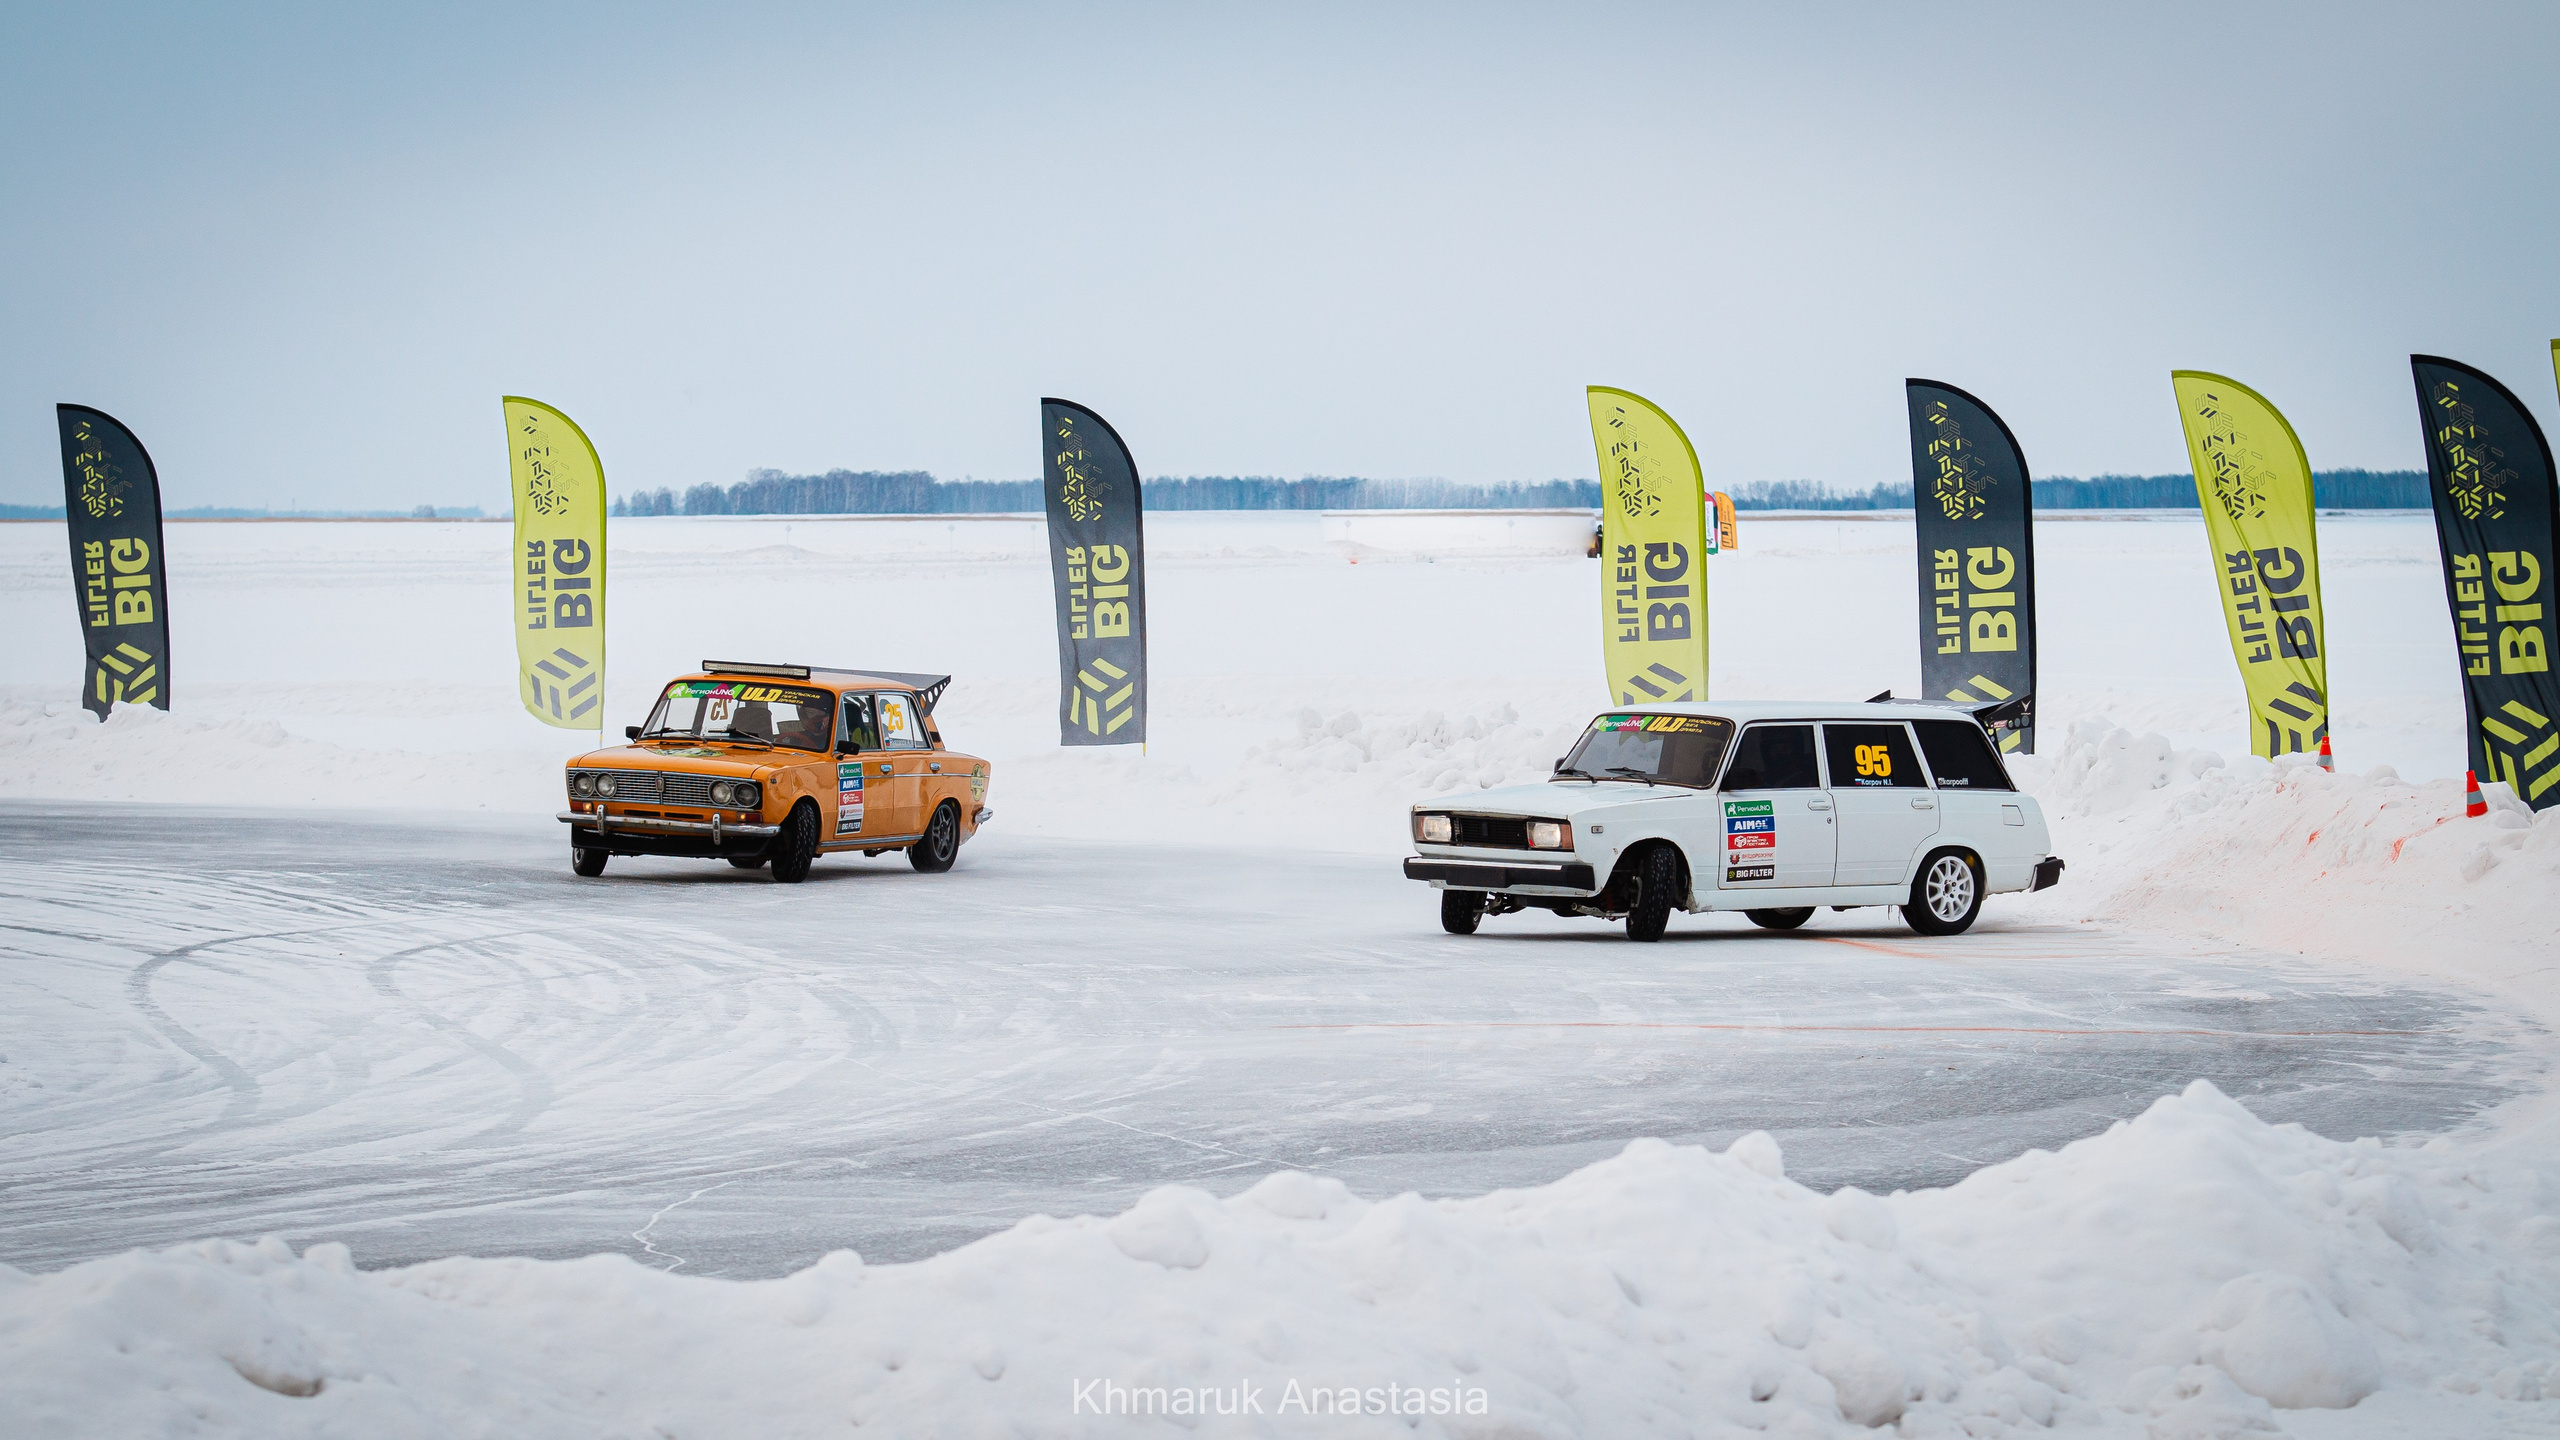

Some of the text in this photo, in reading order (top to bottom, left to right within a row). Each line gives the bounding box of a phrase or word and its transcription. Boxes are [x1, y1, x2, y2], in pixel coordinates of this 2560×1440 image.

[740, 686, 783, 702] ULD
[885, 703, 904, 731] 25
[1647, 716, 1688, 732] ULD
[1854, 744, 1892, 777] 95
[1861, 778, 1882, 787] Karpov
[1734, 820, 1768, 830] AIMOL
[1736, 868, 1773, 878] BIG FILTER
